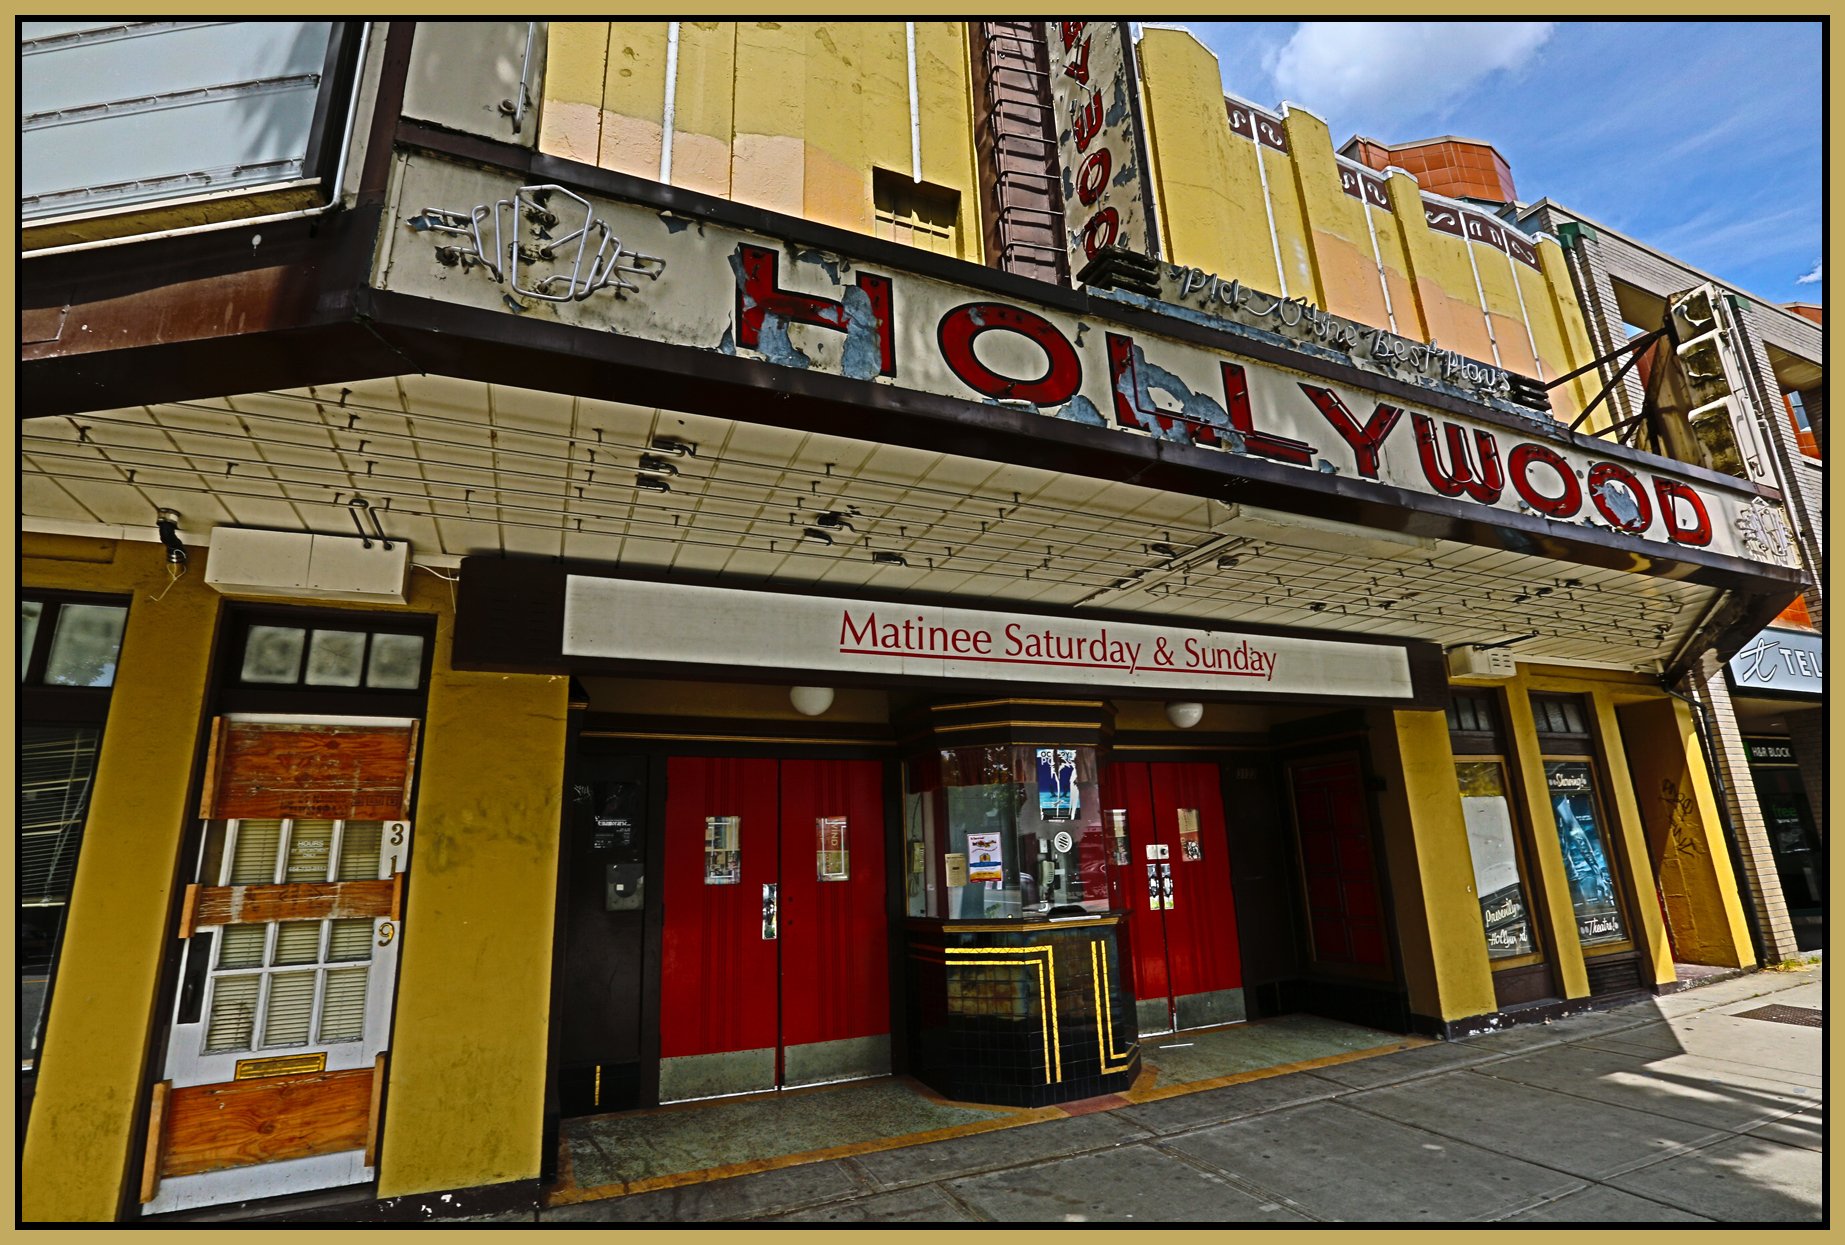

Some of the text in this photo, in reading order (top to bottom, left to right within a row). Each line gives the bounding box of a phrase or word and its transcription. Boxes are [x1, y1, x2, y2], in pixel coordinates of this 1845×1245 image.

[736, 240, 1713, 548] HOLLYWOOD
[840, 610, 1277, 681] Matinee Saturday & Sunday
[1751, 746, 1792, 758] H&R BLOCK
[297, 840, 324, 848] HOURS
